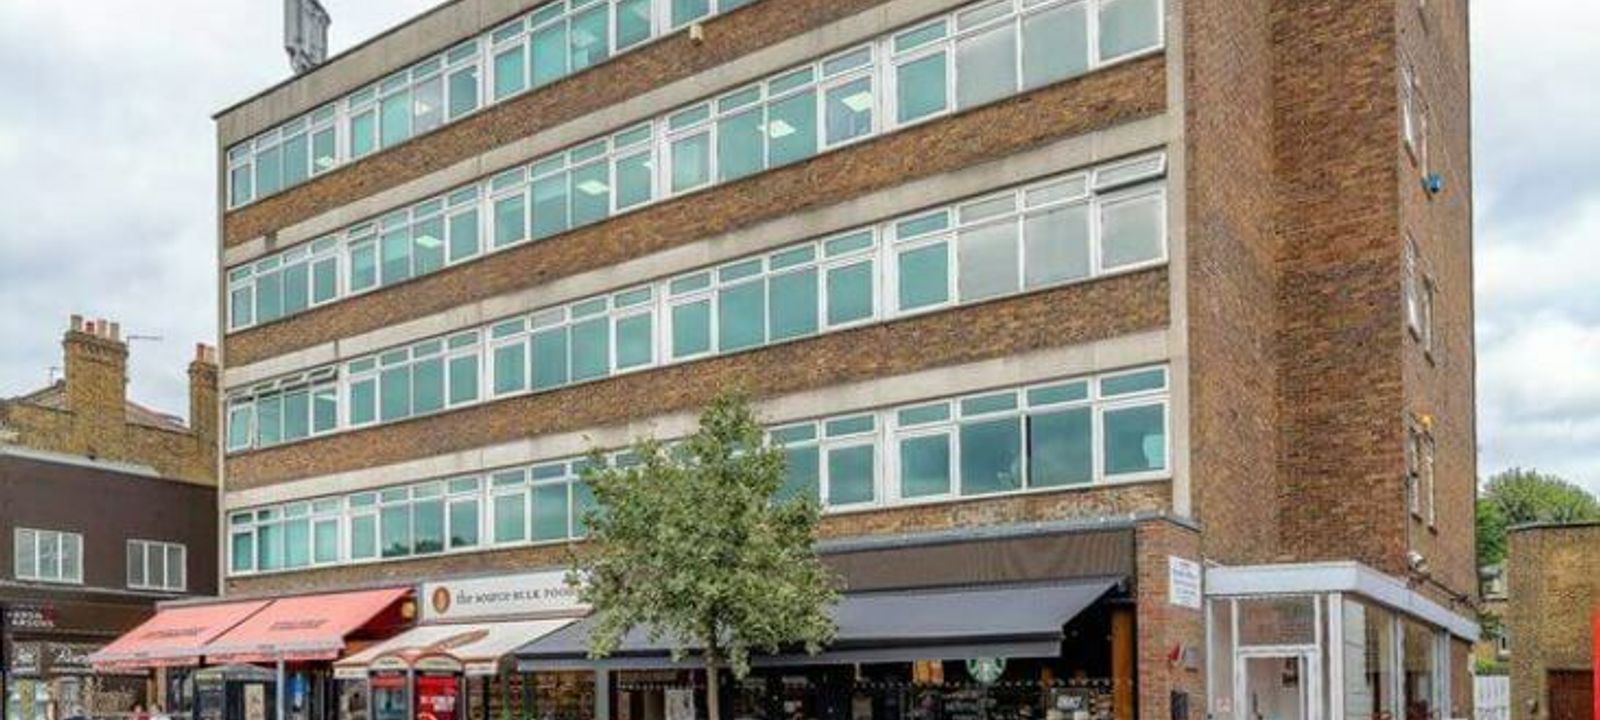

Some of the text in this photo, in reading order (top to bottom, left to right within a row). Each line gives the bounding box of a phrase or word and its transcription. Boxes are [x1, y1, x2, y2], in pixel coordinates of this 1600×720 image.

[456, 590, 473, 604] the
[475, 591, 511, 604] source
[513, 589, 541, 600] BULK
